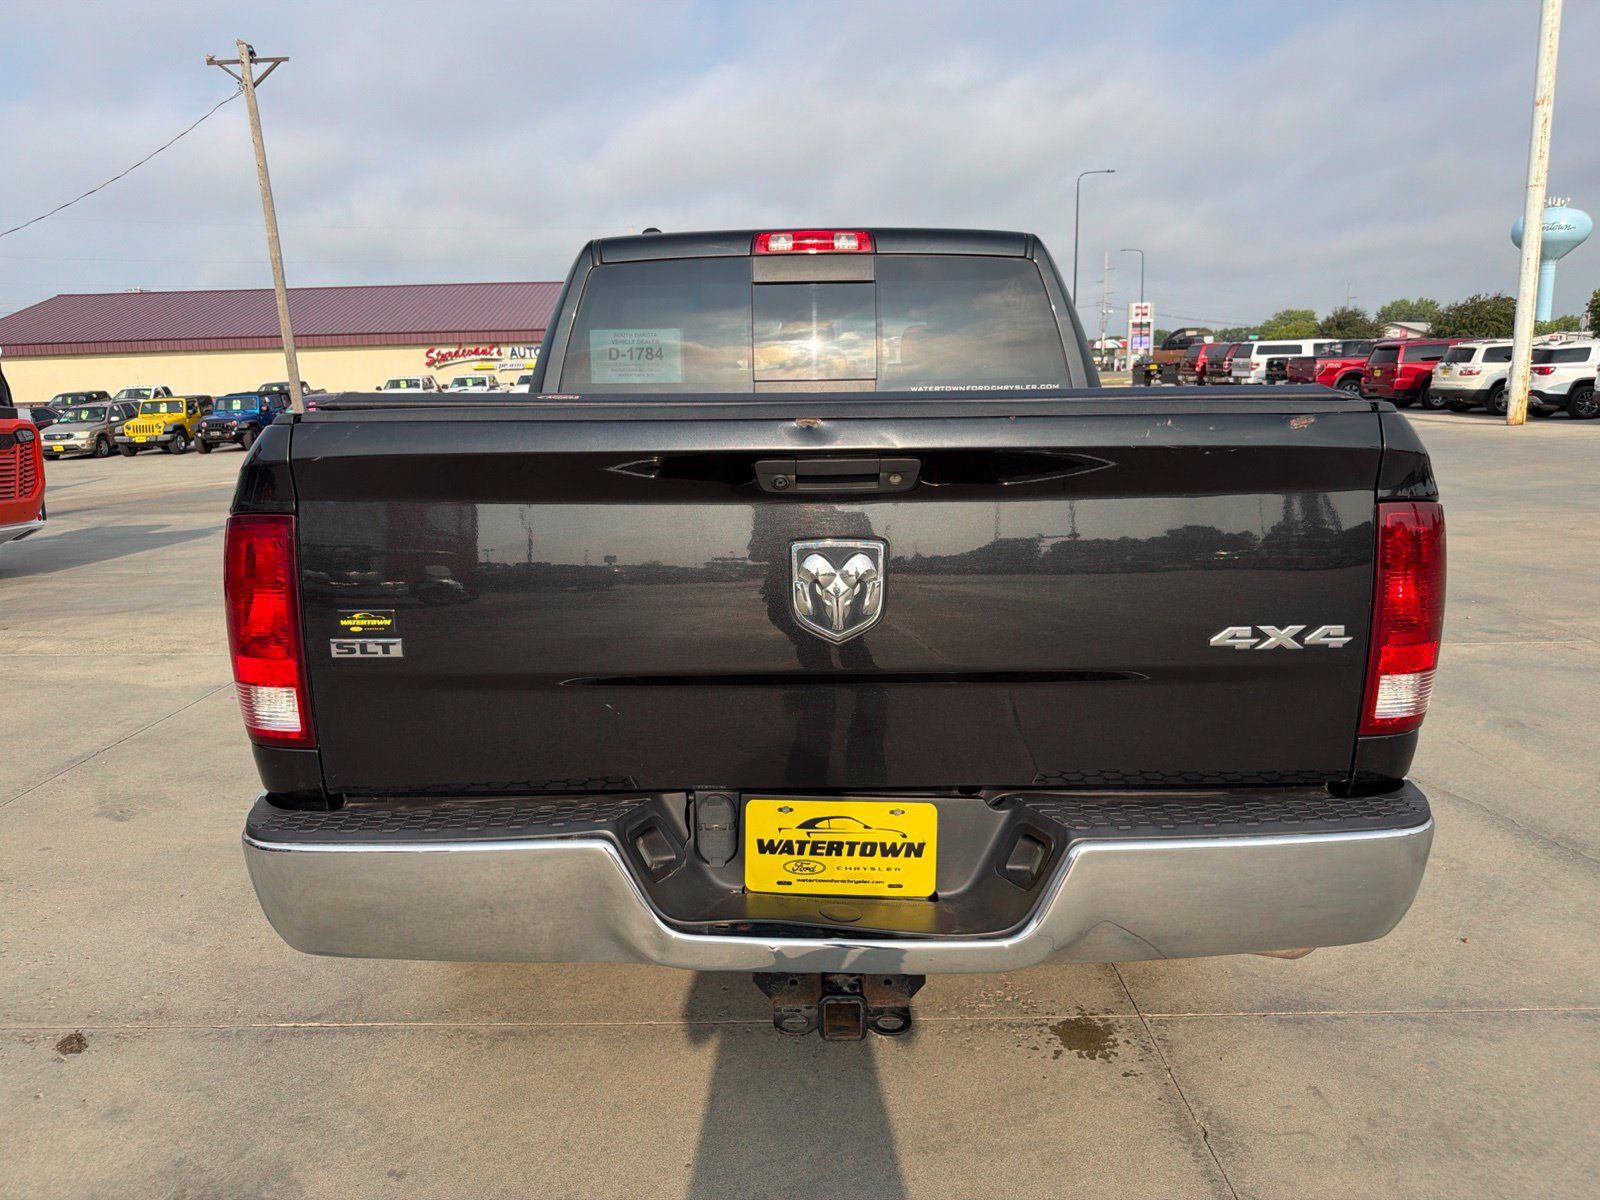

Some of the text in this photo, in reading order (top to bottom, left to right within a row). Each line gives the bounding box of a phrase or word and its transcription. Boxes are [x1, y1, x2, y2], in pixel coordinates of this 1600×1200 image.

[608, 347, 664, 361] D-1784
[910, 384, 1060, 392] WATERTOWNFORDCHRYSLER.COM
[335, 642, 397, 655] SLT
[756, 838, 927, 858] WATERTOWN
[791, 860, 818, 874] Ford
[796, 877, 885, 885] watertownfordchrysler.com
